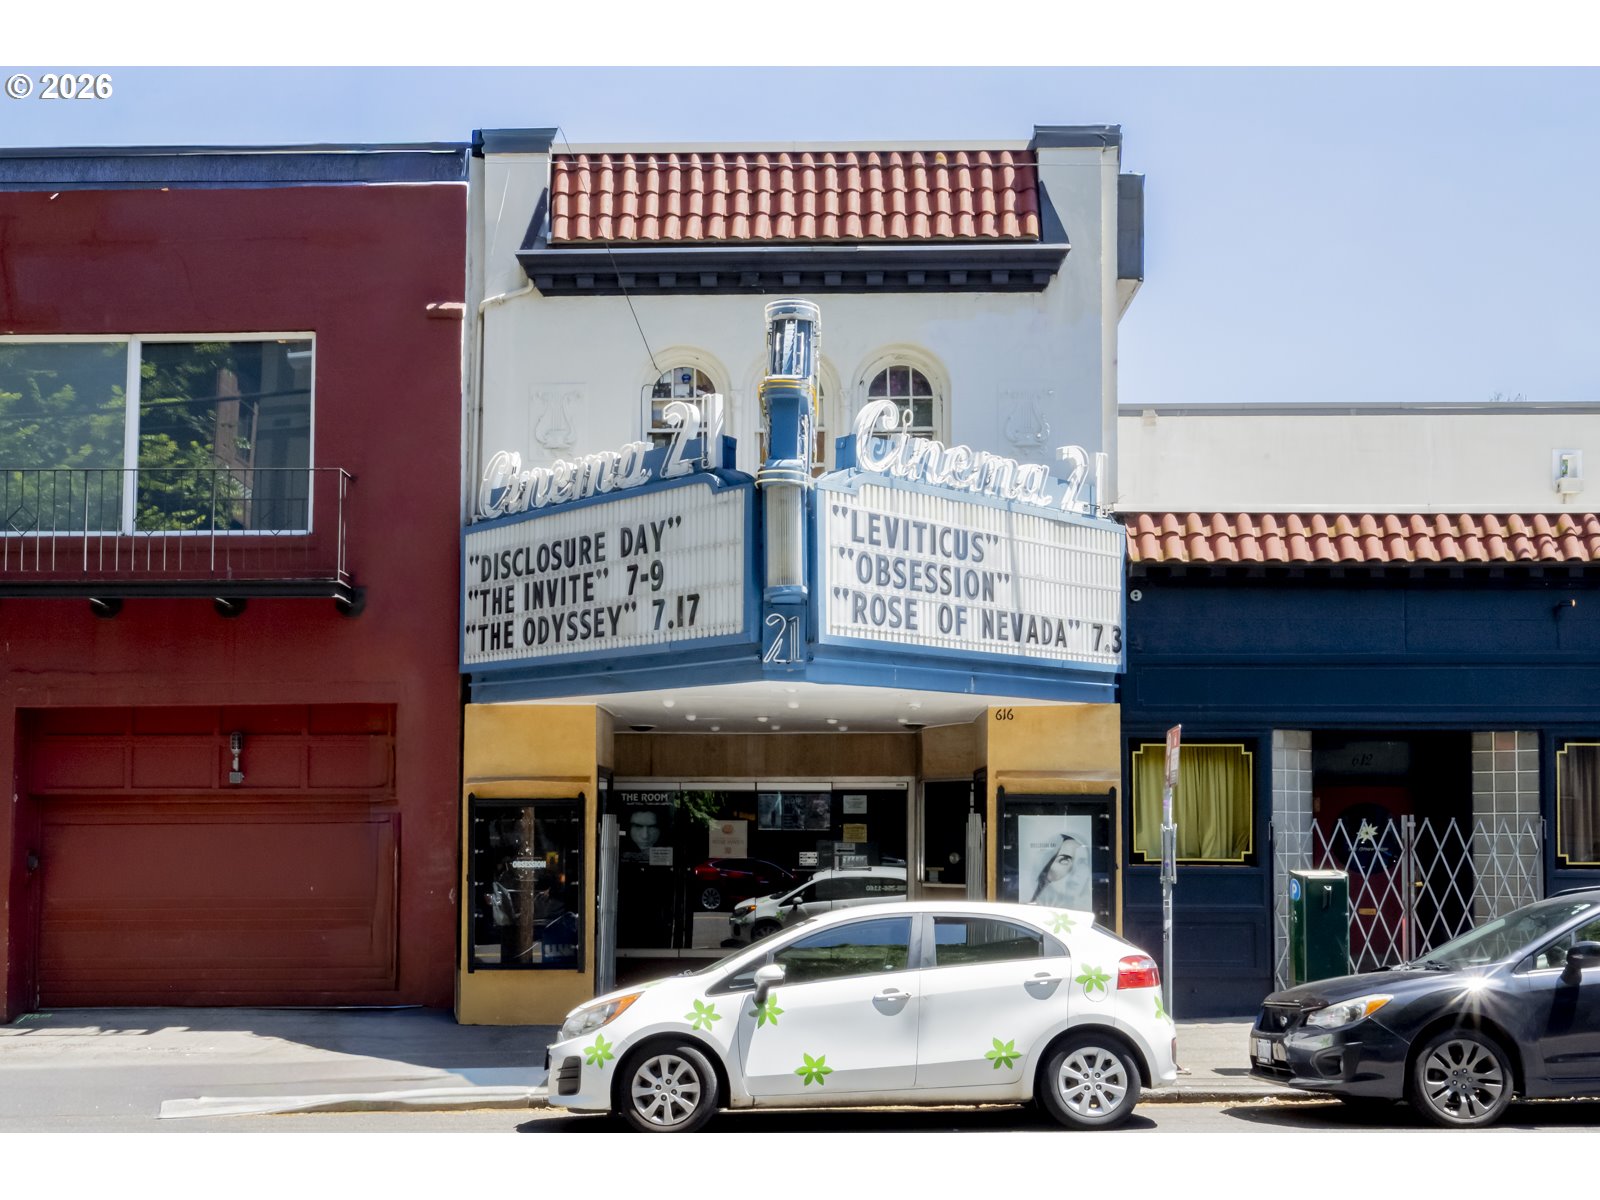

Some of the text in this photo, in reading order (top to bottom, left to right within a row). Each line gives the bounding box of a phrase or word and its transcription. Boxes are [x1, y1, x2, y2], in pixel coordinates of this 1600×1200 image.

[479, 393, 723, 518] Cinema 21
[853, 399, 1112, 517] Cinema 21
[469, 515, 682, 582] "DISCLOSURE DAY"
[832, 504, 999, 563] "LEVITICUS"
[468, 559, 664, 617] "THE INVITE" 7-9
[838, 546, 1010, 602] "OBSESSION"
[465, 593, 700, 651] "THE ODYSSEY" 7.17
[763, 613, 804, 663] 21
[833, 586, 1122, 654] "ROSE OF NEVADA" 7.3
[995, 708, 1014, 721] 616
[621, 793, 669, 802] THE ROOM
[512, 860, 547, 869] OBSESSION
